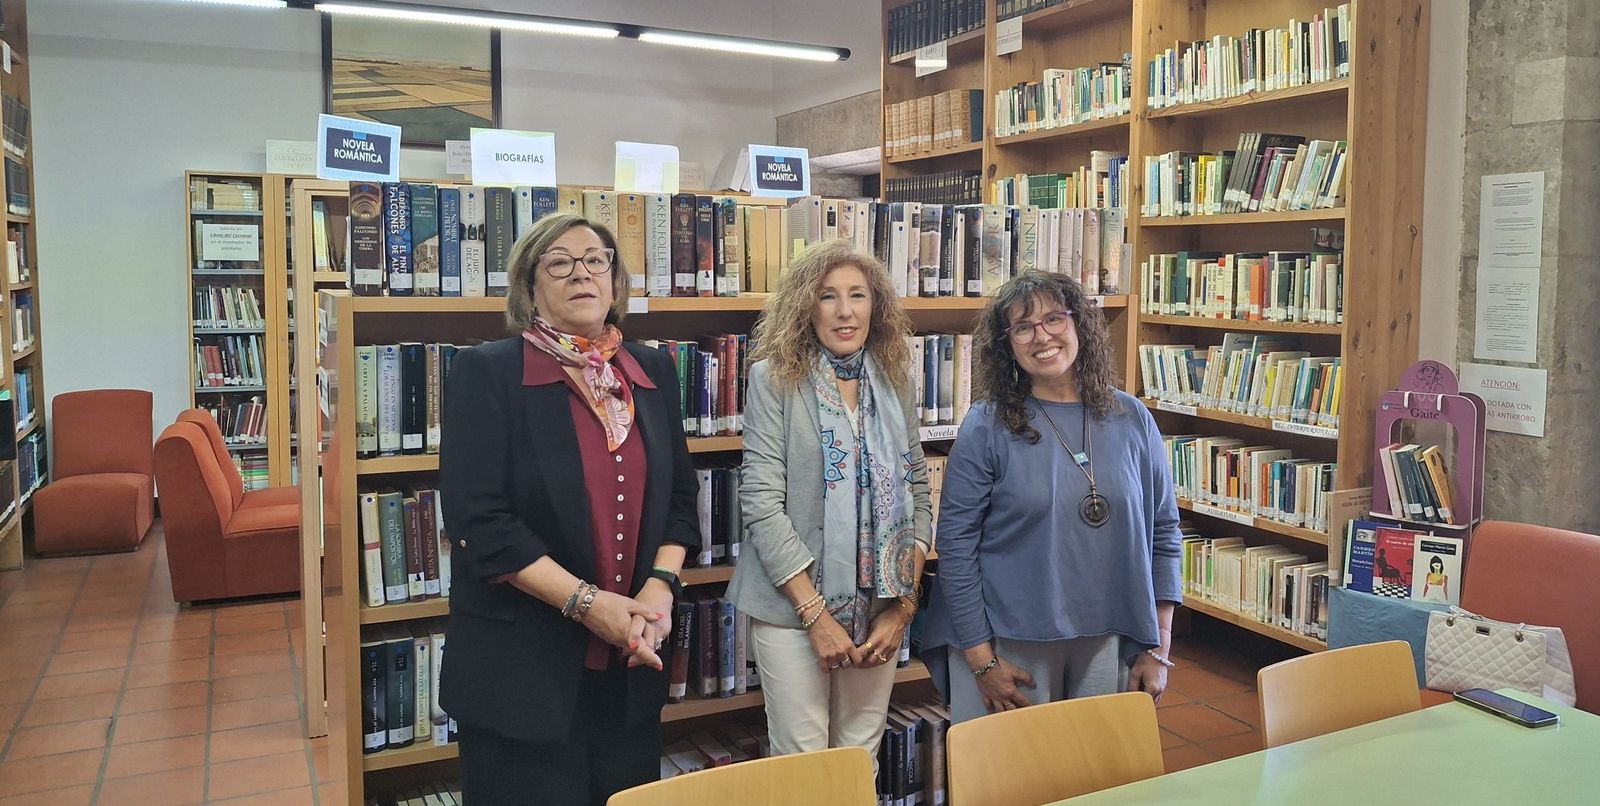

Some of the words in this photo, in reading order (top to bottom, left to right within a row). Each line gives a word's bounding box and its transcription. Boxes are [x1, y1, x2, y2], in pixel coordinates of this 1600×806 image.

[342, 138, 375, 152] NOVELA
[334, 148, 383, 164] ROMÁNTICA
[495, 152, 544, 164] BIOGRAFÍAS
[768, 162, 792, 172] NOVELA
[762, 171, 798, 182] ROMÁNTICA
[390, 186, 399, 234] FALCONES
[601, 203, 610, 224] KEN
[656, 204, 666, 228] KEN
[392, 245, 399, 254] DE
[400, 245, 406, 253] EL
[657, 231, 667, 277] FOLLETT
[392, 256, 400, 274] ALM
[1481, 378, 1520, 389] ATENCIÓN:
[1410, 408, 1440, 419] Gaite
[1497, 412, 1536, 422] ANTIRROBO
[928, 428, 954, 437] Novela
[684, 612, 692, 648] RELÁMPAGO
